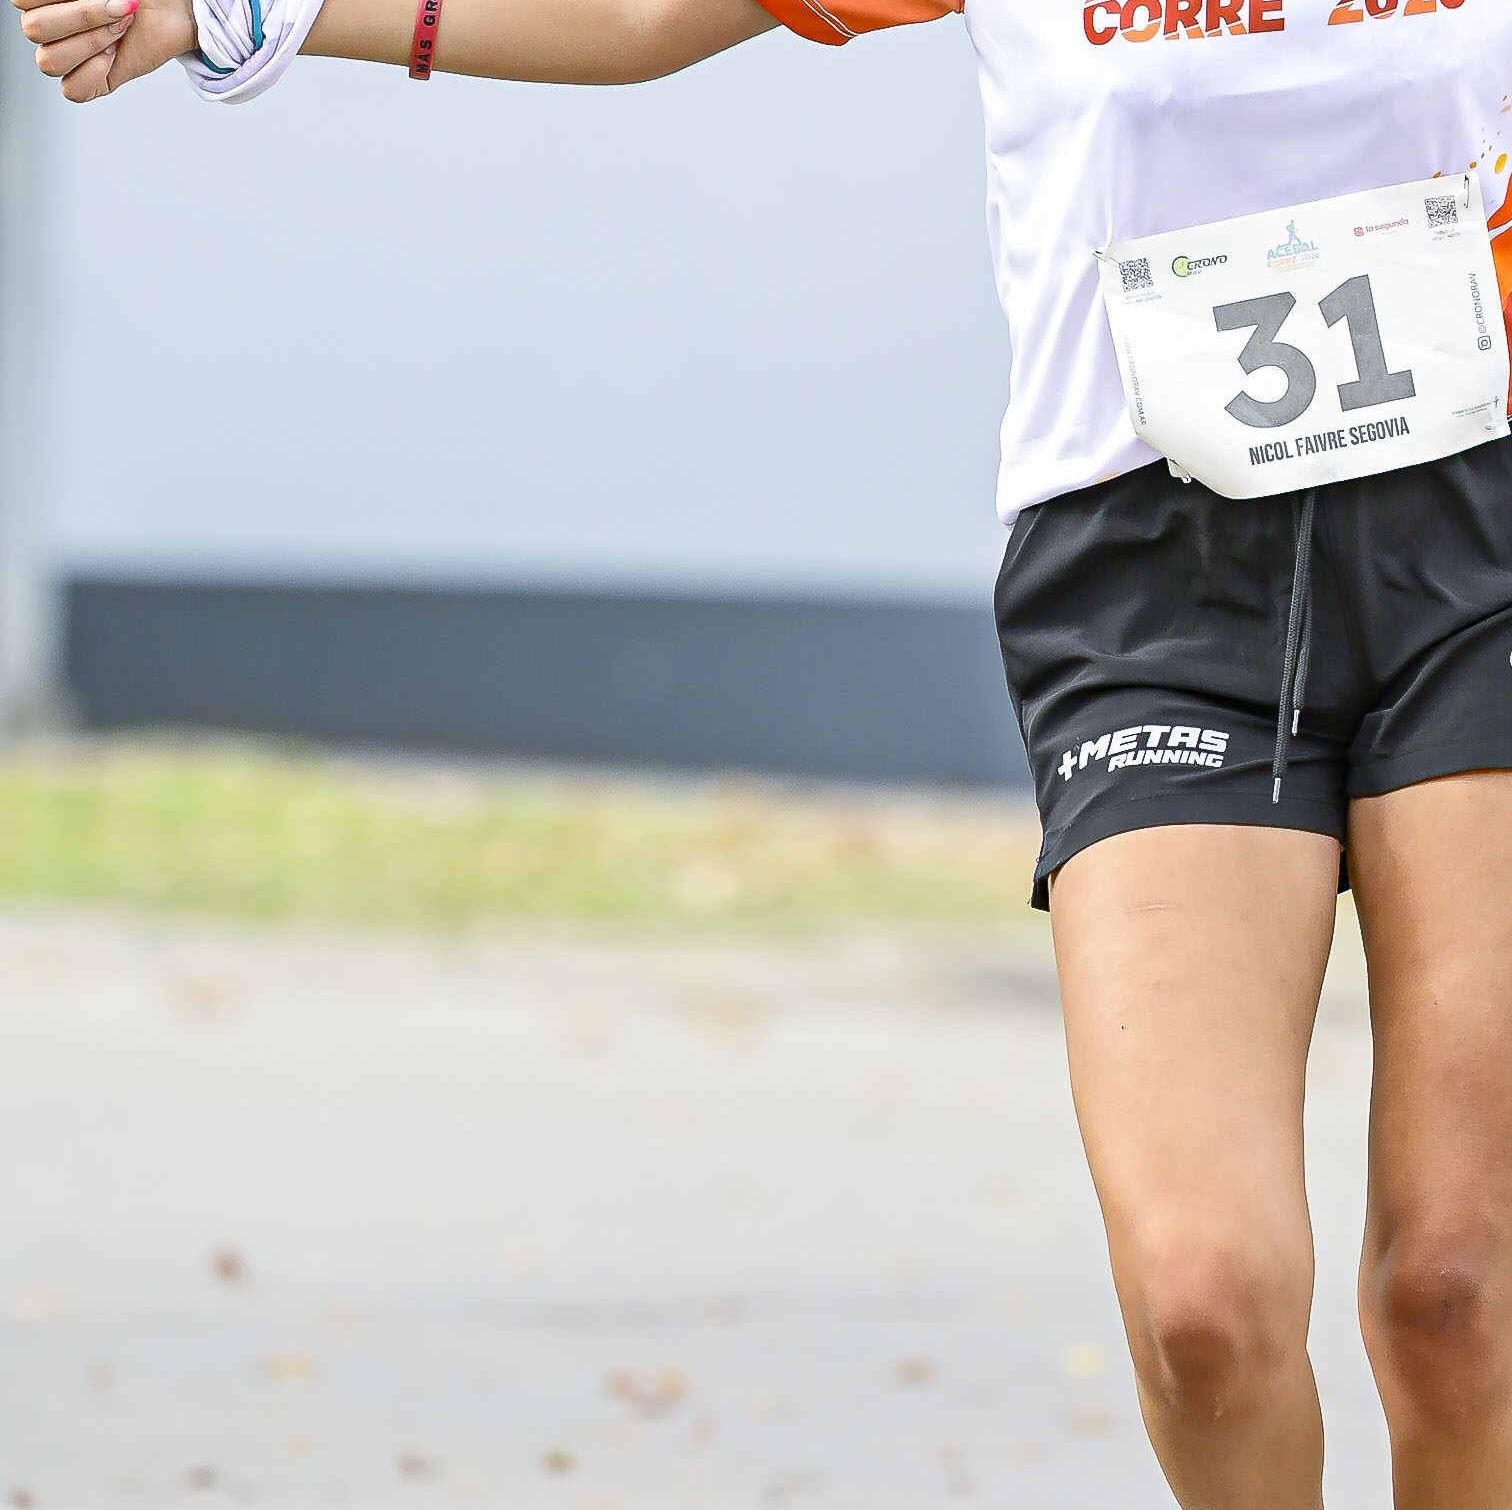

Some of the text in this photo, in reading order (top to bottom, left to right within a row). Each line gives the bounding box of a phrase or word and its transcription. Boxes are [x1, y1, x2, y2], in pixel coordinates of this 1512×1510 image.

[1375, 217, 1409, 231] segunda
[1267, 240, 1318, 259] ACEBAL
[1187, 255, 1227, 271] CRONO
[1468, 273, 1487, 334] @CRONORAV
[1212, 274, 1416, 428] 31
[1249, 416, 1410, 466] NICOL FAIVRE SEGOVIA
[1107, 749, 1225, 773] RUNNING
